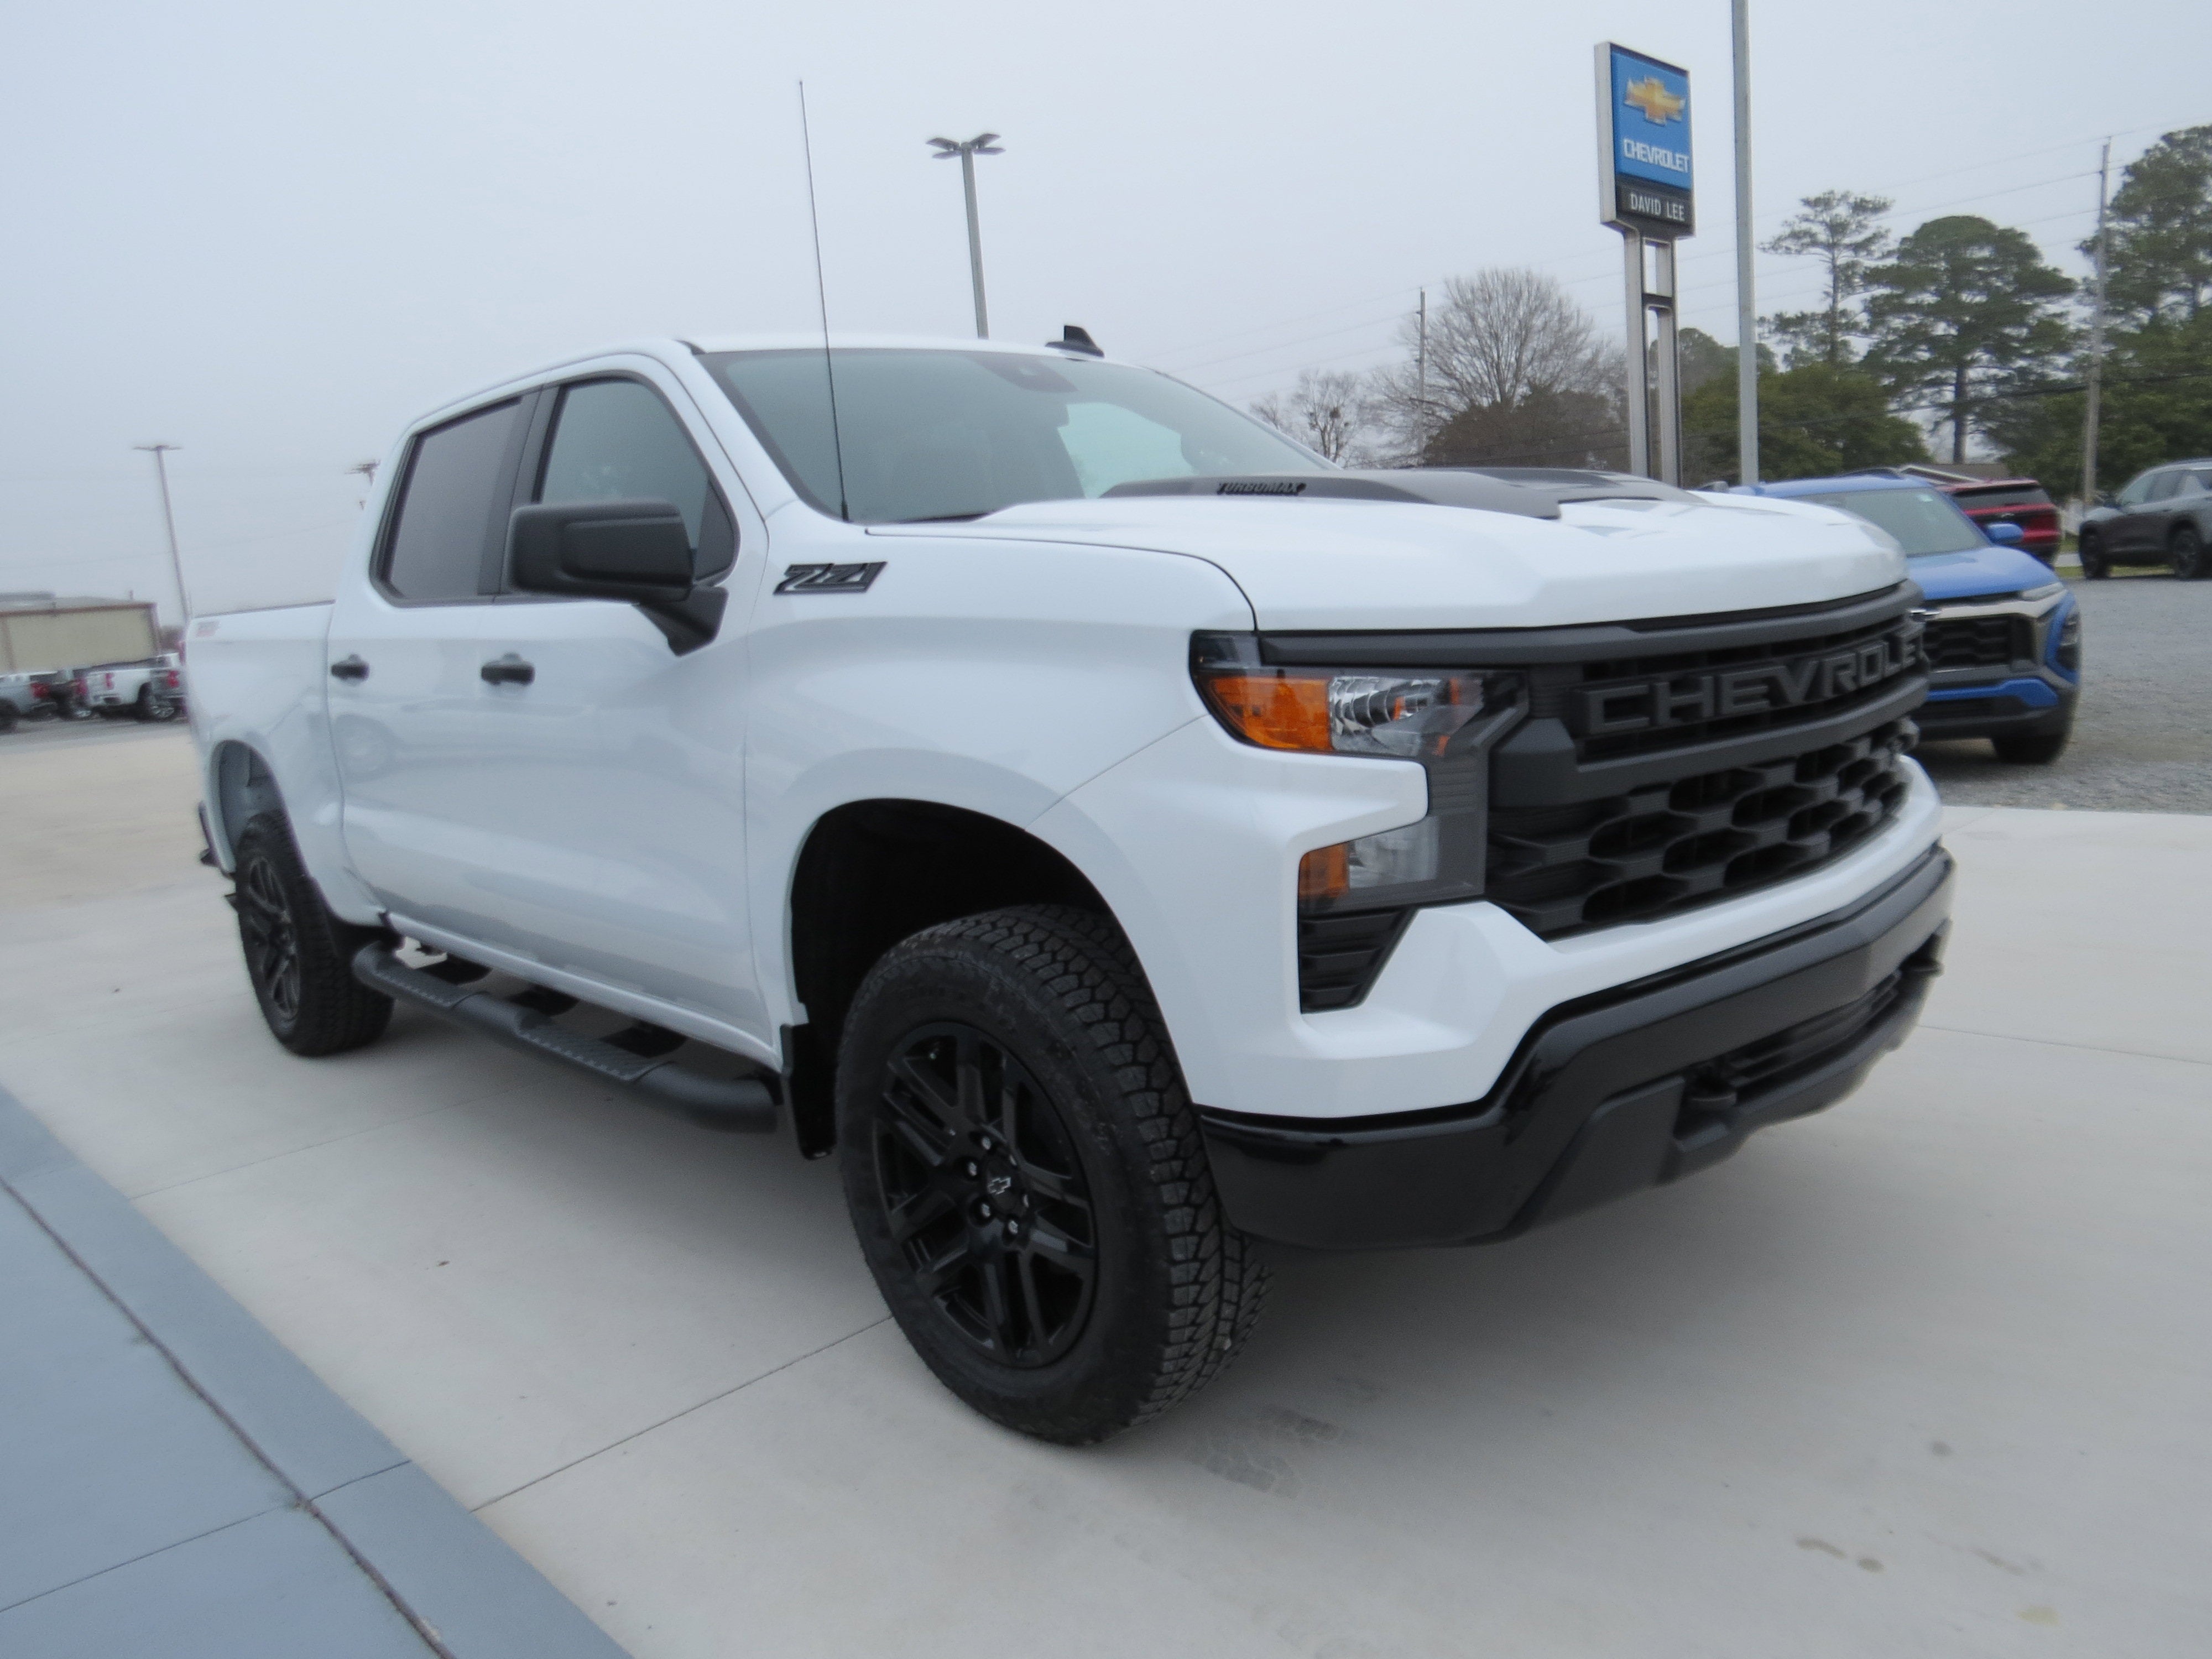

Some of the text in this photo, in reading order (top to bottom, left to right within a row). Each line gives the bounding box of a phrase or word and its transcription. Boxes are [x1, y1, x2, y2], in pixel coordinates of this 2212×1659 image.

[1623, 138, 1689, 173] CHEVROLET
[1631, 194, 1686, 221] DAVID LEE
[1217, 482, 1305, 496] TURBOMAX
[773, 561, 888, 595] Z71
